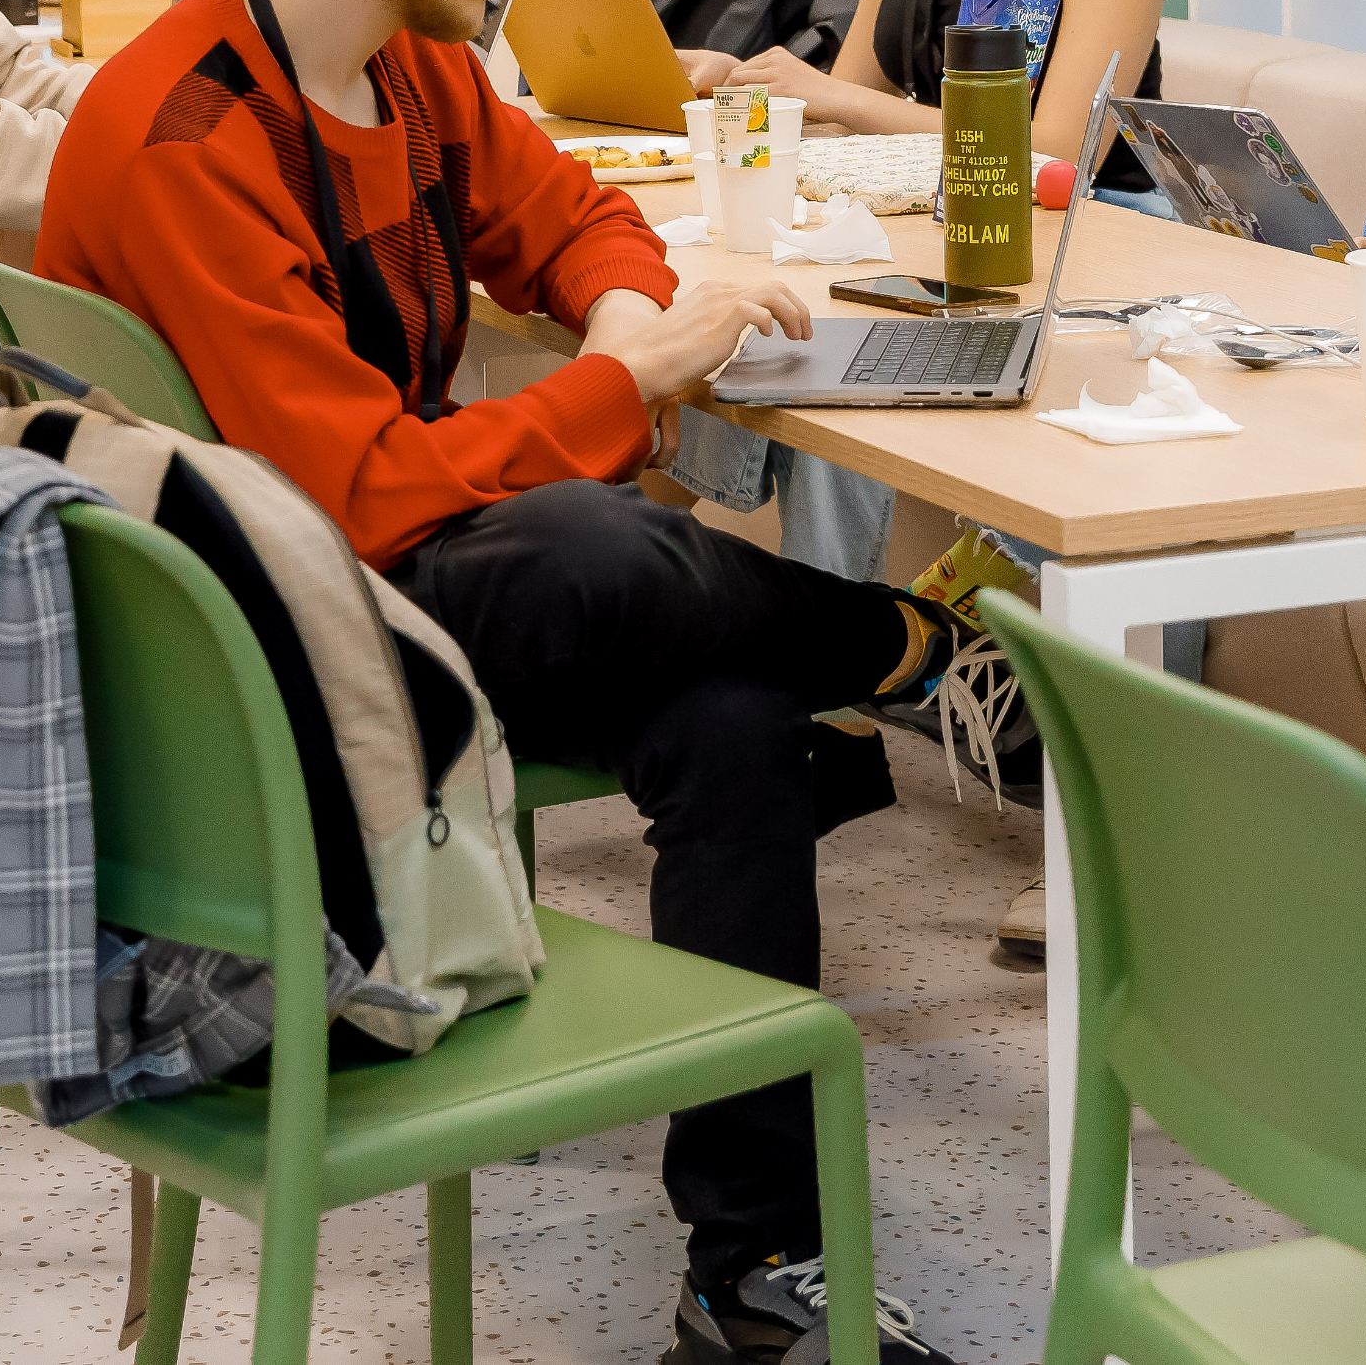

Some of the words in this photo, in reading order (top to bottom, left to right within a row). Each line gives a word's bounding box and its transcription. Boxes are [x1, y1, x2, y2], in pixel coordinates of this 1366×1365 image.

[955, 129, 984, 143] 155H
[960, 145, 976, 154] TNT
[946, 181, 988, 197] SUPPLY
[992, 182, 1019, 197] CHG
